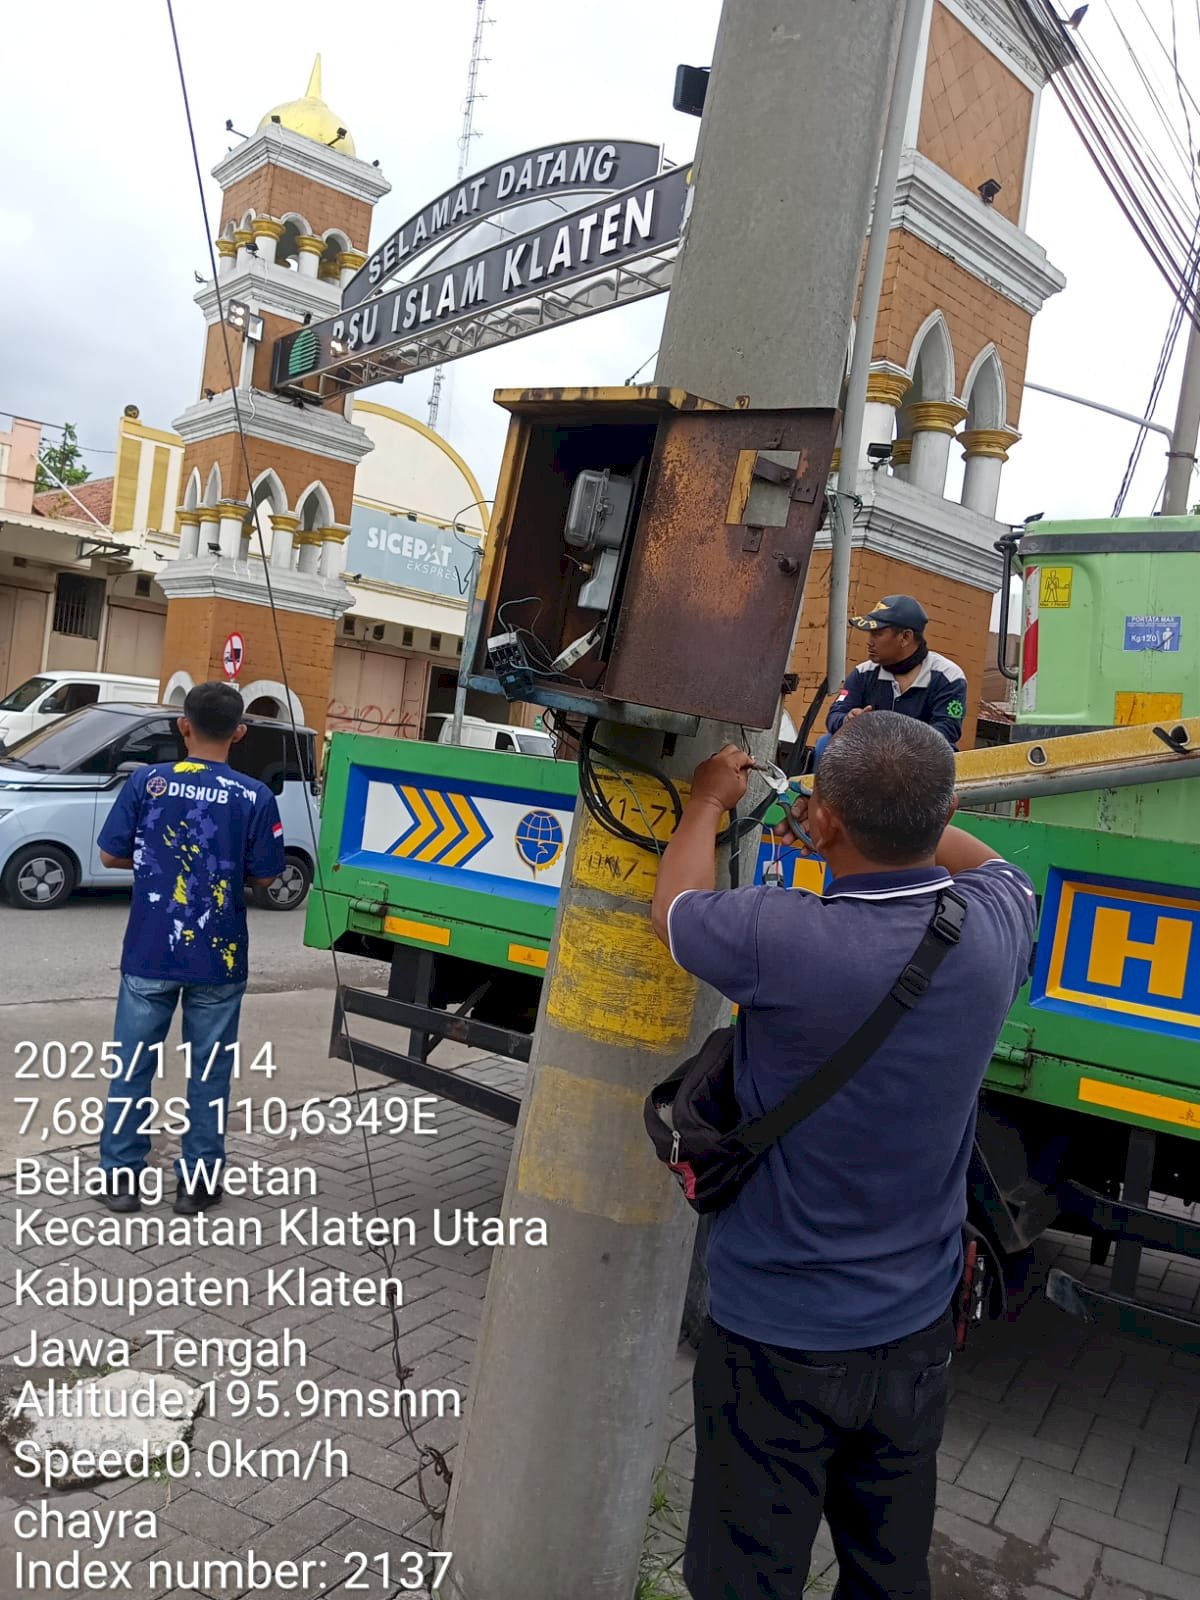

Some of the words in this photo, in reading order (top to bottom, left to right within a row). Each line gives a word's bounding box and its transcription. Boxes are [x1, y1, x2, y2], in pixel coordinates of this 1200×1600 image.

[369, 177, 487, 284] SELAMAT
[497, 145, 616, 199] DATANG
[391, 260, 488, 333] ISLAM
[502, 188, 655, 292] KLATEN
[367, 527, 452, 567] SICEPAT
[168, 782, 229, 804] DISHUB
